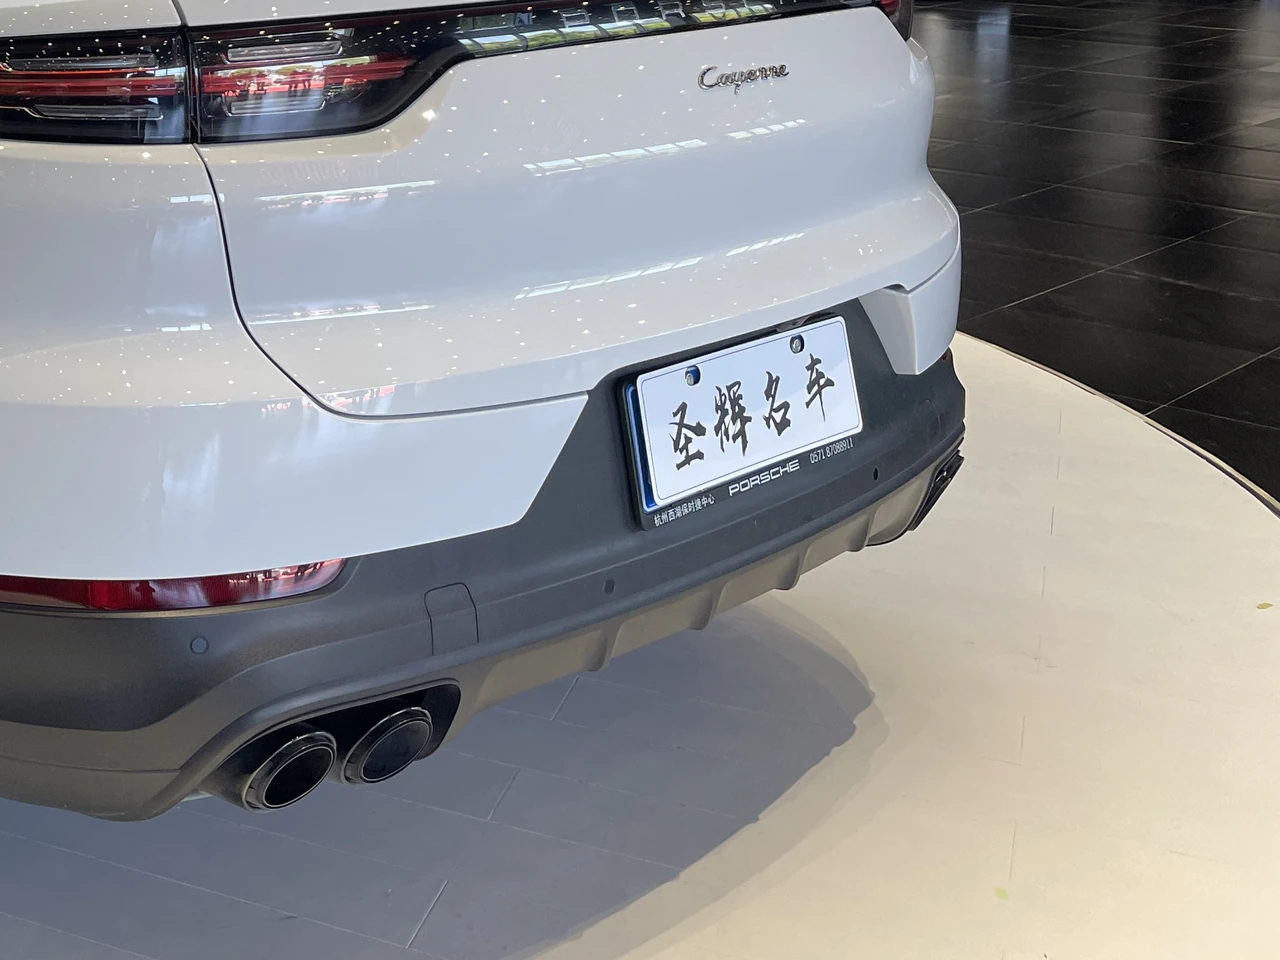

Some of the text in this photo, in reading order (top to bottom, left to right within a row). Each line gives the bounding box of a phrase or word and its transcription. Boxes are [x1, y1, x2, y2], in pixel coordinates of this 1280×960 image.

[698, 64, 790, 95] Cayenne
[669, 353, 835, 471] 圣辉名车
[653, 493, 715, 527] 杭州西湖保时捷中心
[729, 459, 801, 496] PORSCHE
[809, 448, 826, 464] 0571
